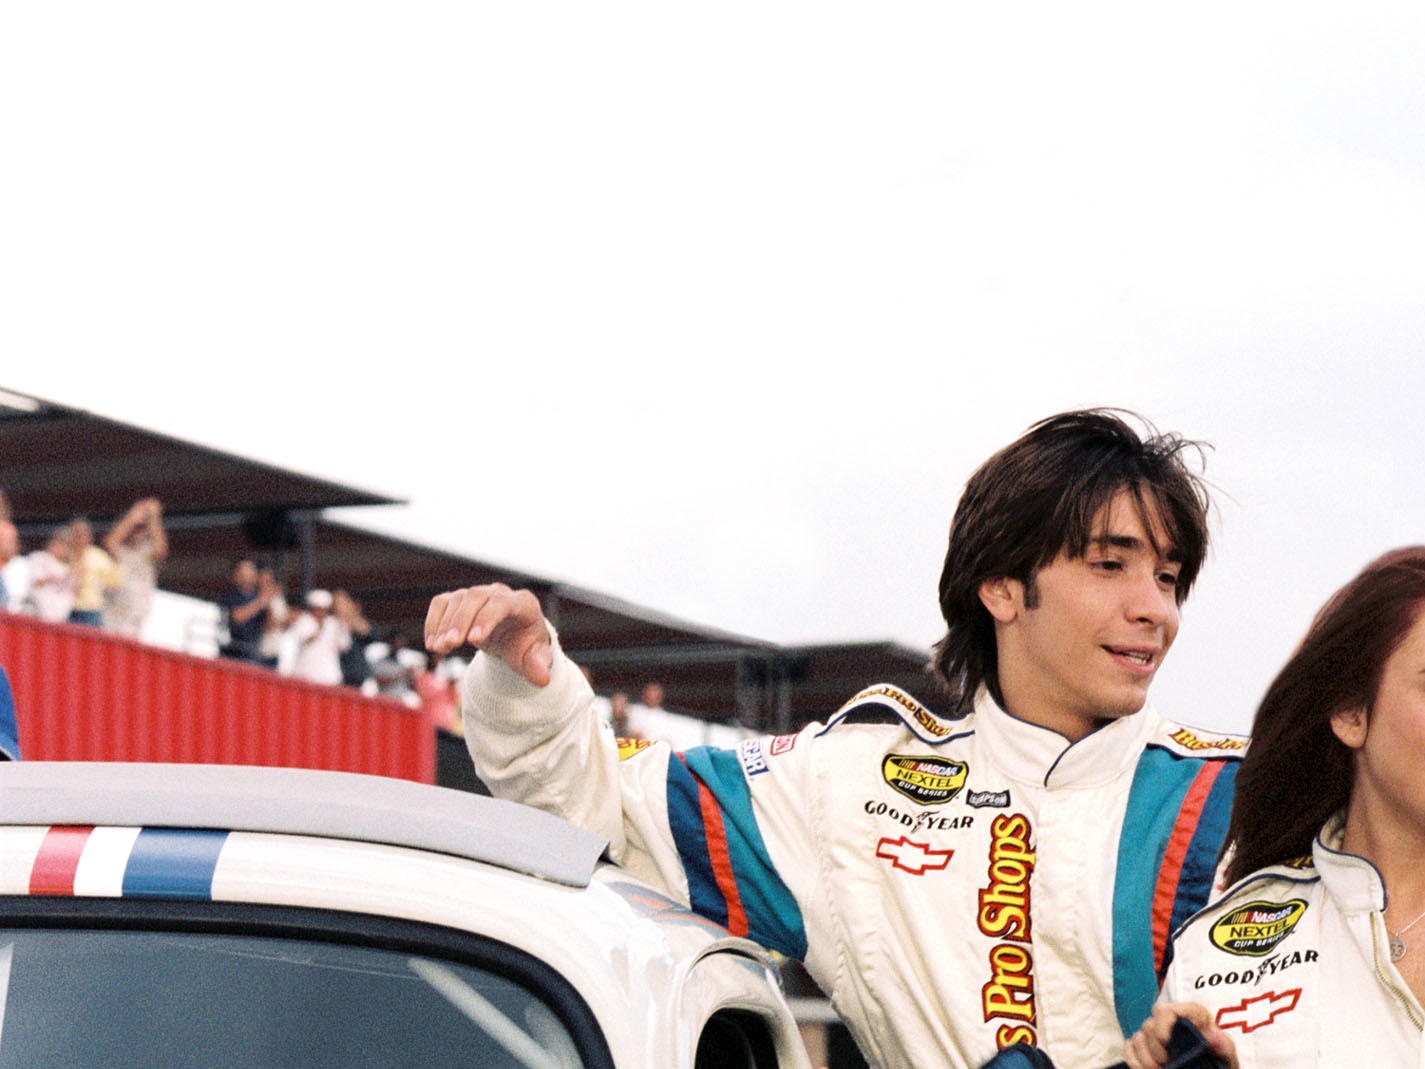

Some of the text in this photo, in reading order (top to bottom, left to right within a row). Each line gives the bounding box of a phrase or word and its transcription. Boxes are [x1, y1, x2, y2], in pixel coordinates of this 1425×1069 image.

[883, 687, 917, 711] Pro
[1168, 728, 1219, 750] Bass
[896, 769, 954, 788] NEXTEL
[915, 762, 959, 777] NASCAR
[898, 781, 949, 797] CUP SERIES
[864, 800, 975, 833] GOODYEAR
[977, 813, 1037, 944] Shops
[1251, 905, 1294, 923] NASCAR
[1229, 919, 1291, 938] NEXTEL
[1233, 940, 1254, 948] CUP
[1194, 949, 1320, 989] GOODYEAR
[982, 943, 1037, 1028] Pro
